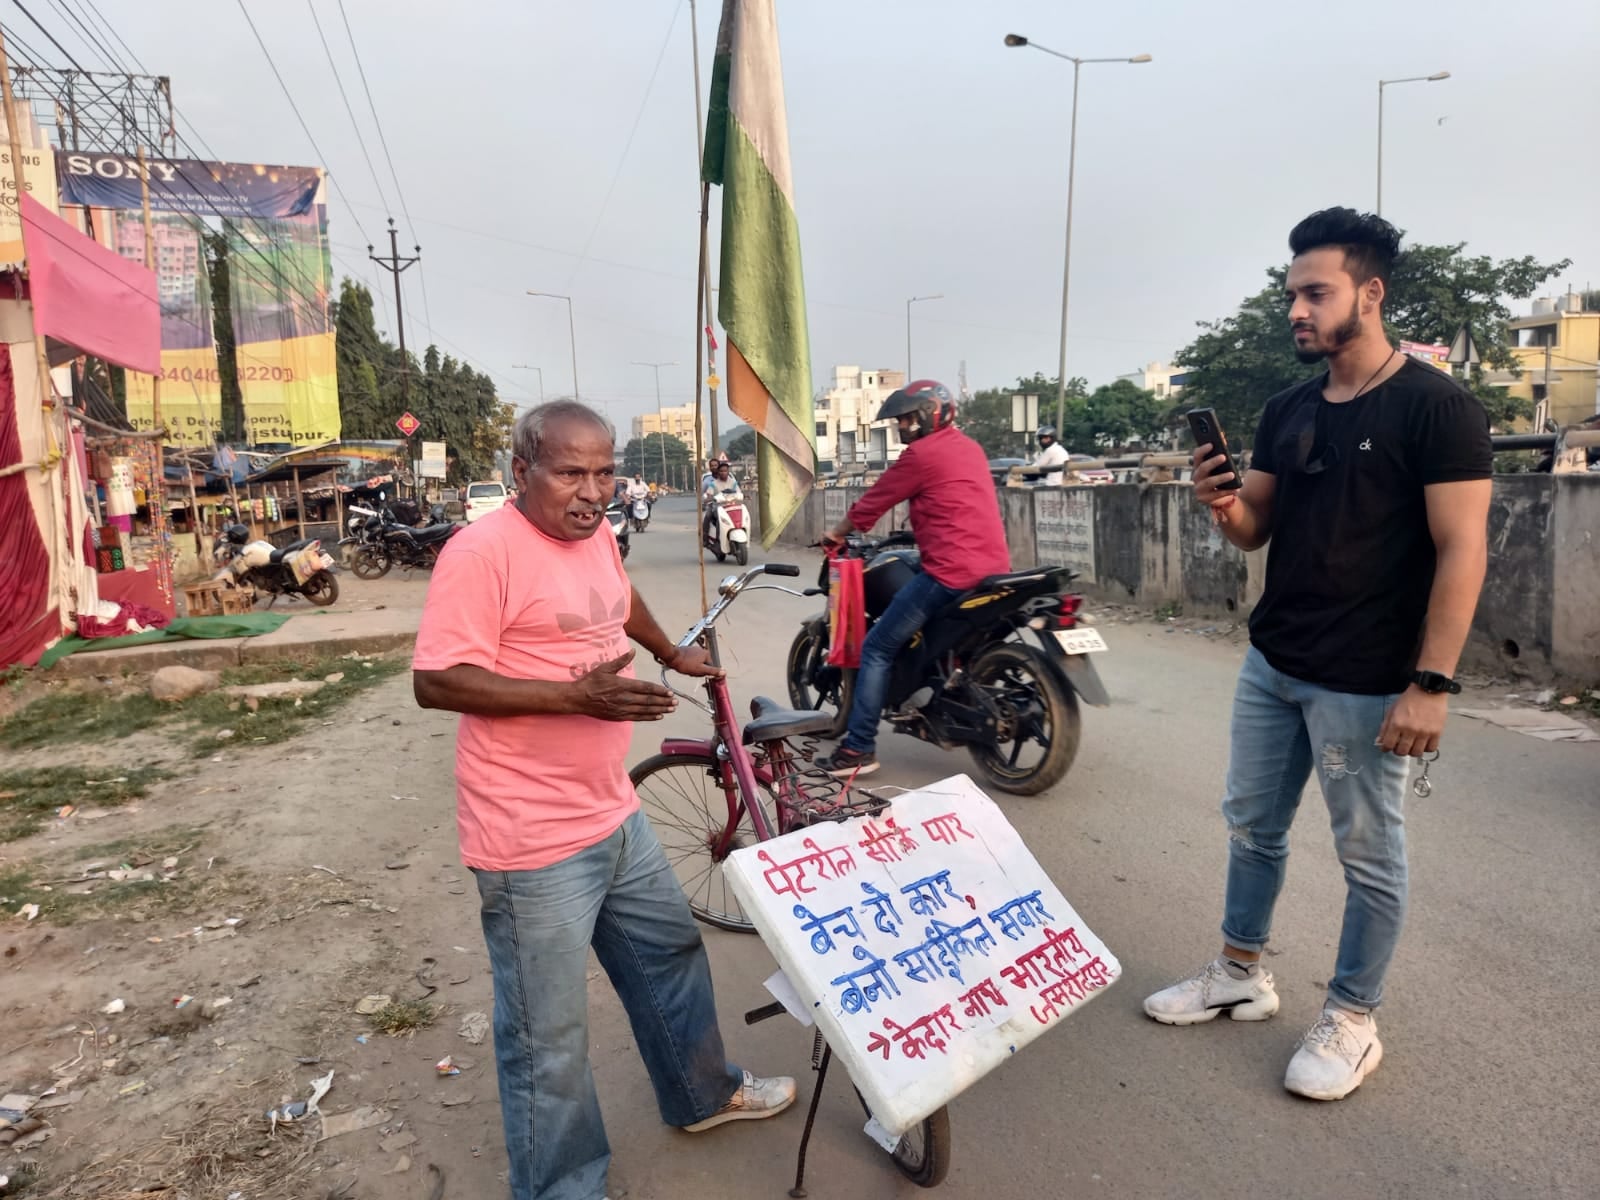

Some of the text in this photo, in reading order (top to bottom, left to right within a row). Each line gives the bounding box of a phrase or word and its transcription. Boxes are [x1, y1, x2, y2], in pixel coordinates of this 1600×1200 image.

[1, 153, 41, 167] SNG
[67, 155, 181, 182] SONY
[1, 176, 33, 191] fes
[920, 812, 975, 846] पार
[793, 904, 867, 955] बेच
[861, 881, 903, 938] दो
[830, 945, 901, 1015] बनो
[988, 890, 1055, 941] सवार
[885, 1017, 963, 1060] केदार
[1000, 927, 1092, 989] भारतीय
